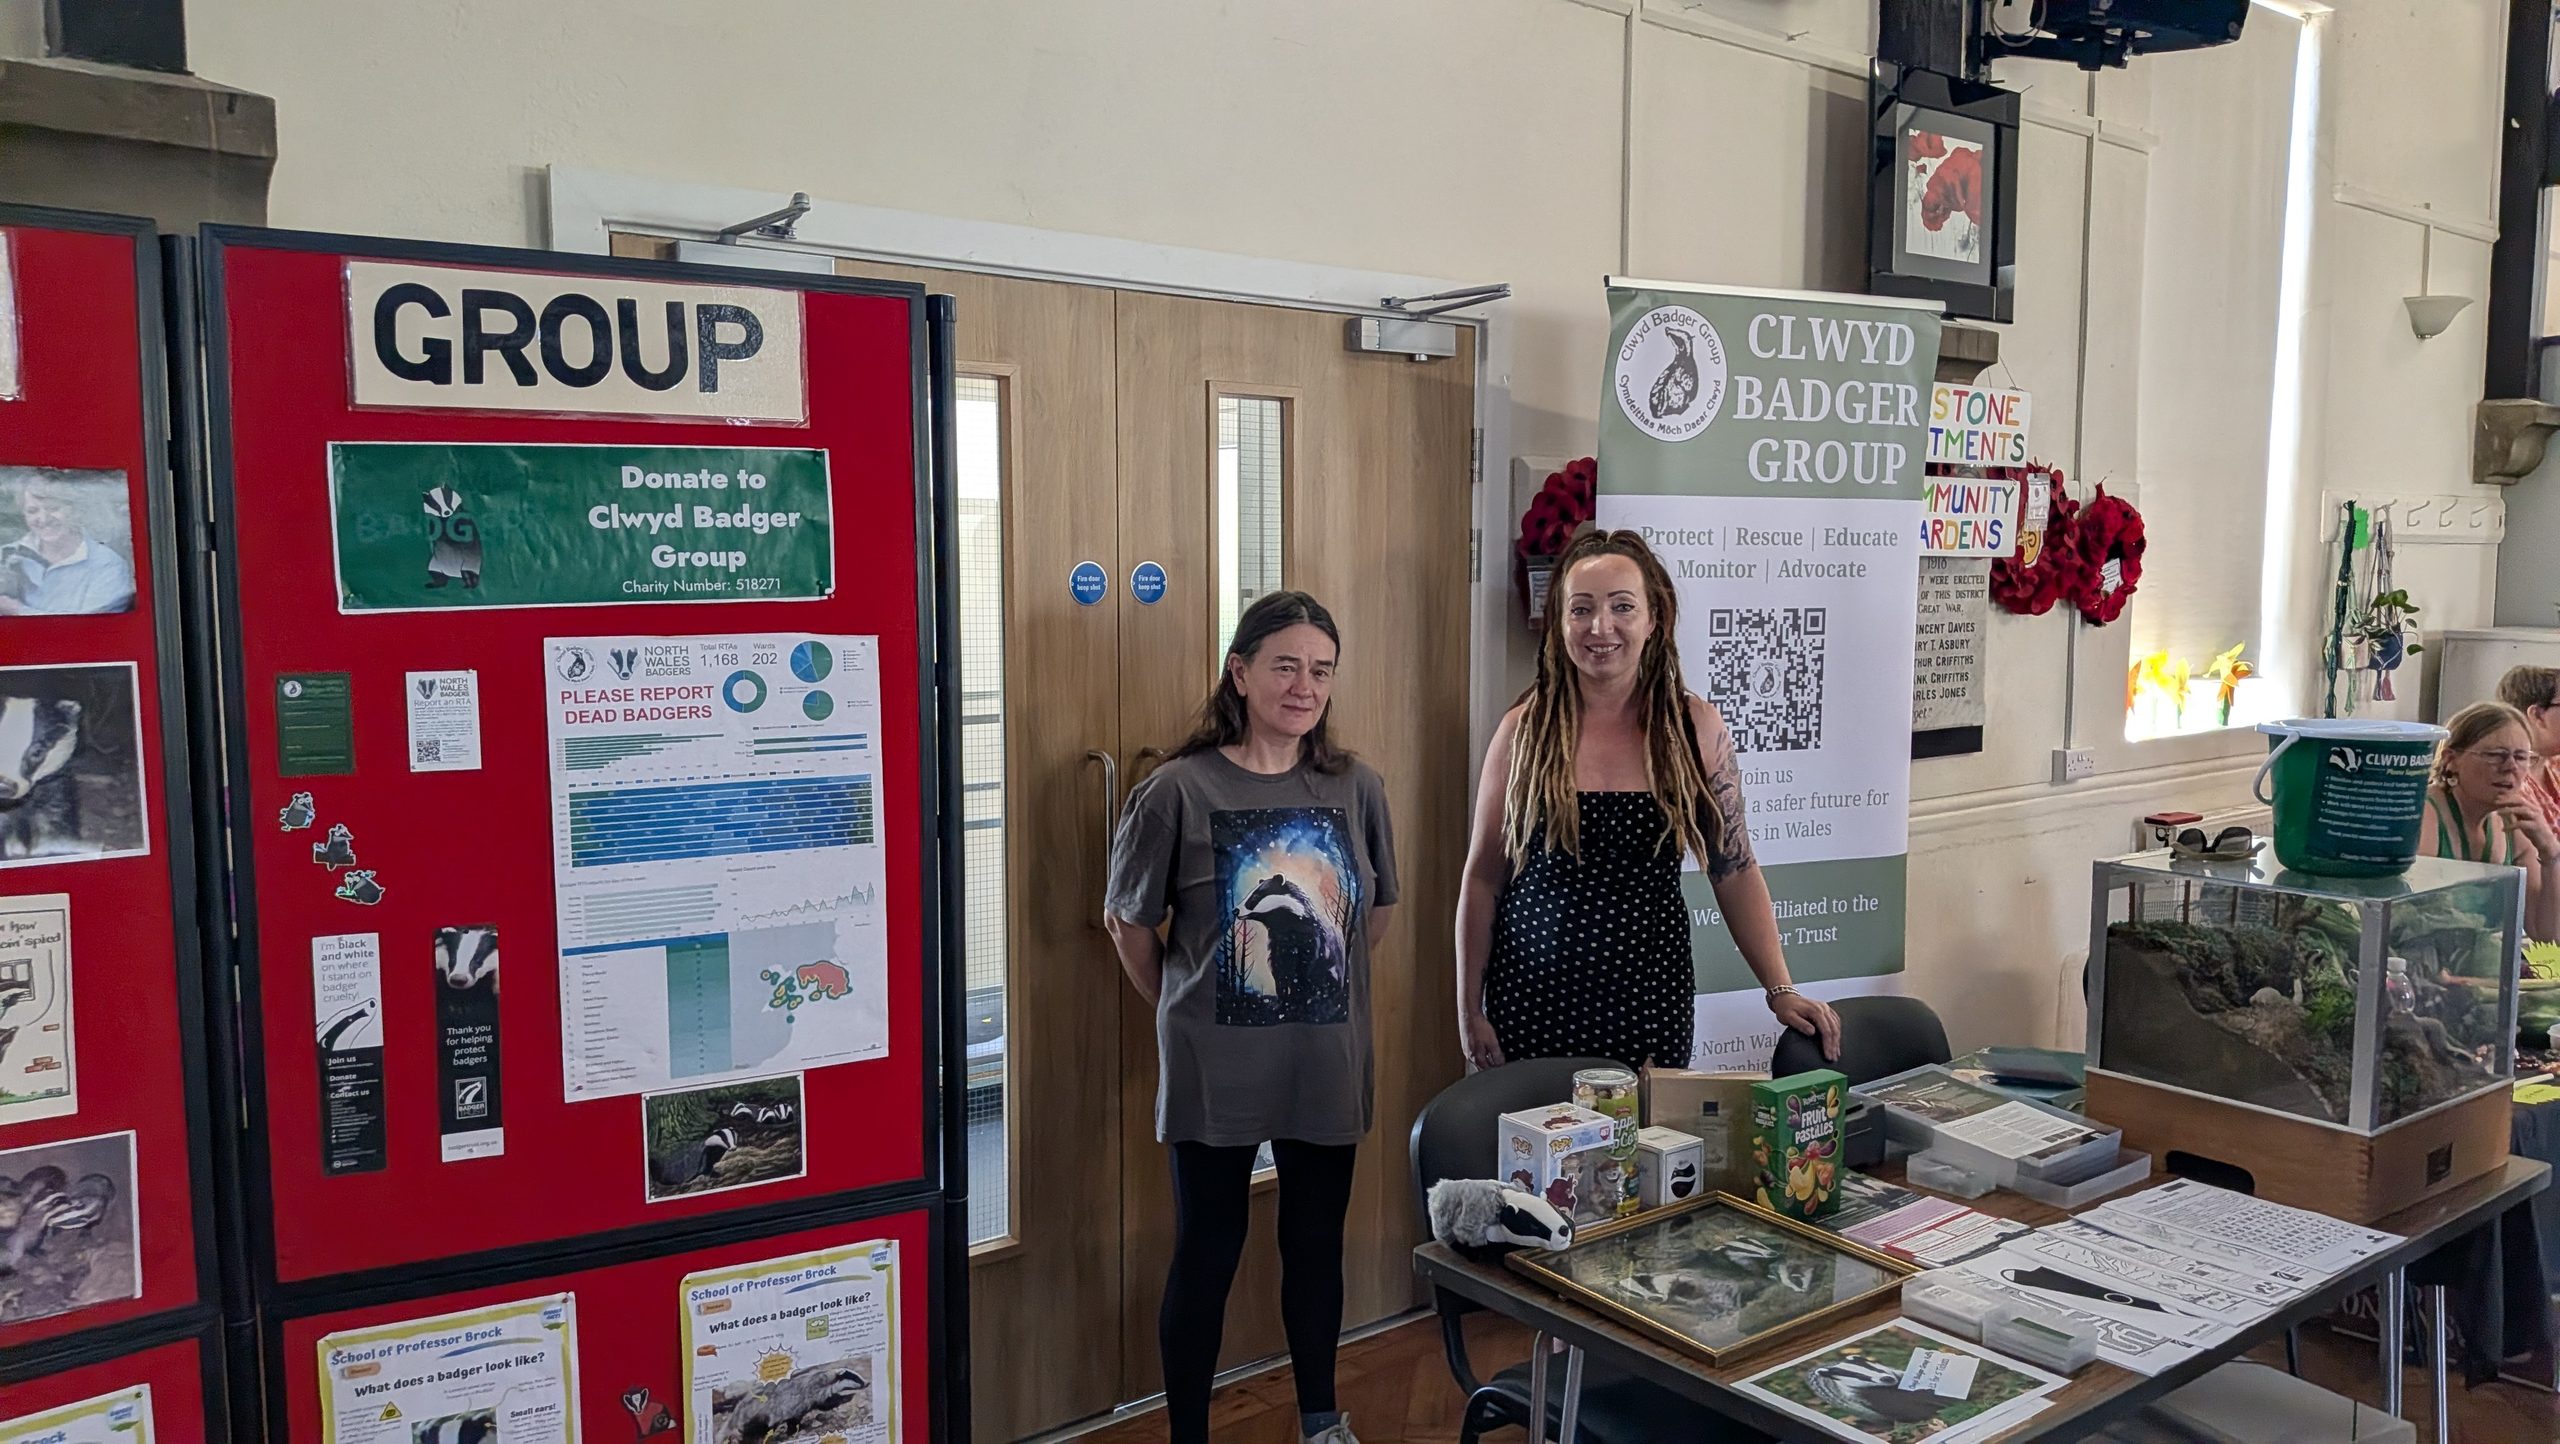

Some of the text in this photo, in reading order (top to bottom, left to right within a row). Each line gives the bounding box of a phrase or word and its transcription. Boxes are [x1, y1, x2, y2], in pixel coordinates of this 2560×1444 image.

[373, 282, 764, 394] GROUP
[1621, 309, 1721, 365] Clwyd Badger Group
[1748, 313, 1915, 366] CLWYD
[1706, 380, 1721, 411] Clwyd
[1733, 376, 1919, 427] BADGER
[1929, 427, 2025, 463] TMENTS
[1748, 438, 1907, 485] GROUP
[621, 466, 766, 490] Donate to
[1923, 482, 2016, 517] MMUNITY
[588, 504, 800, 535] Clwyd Badger
[1641, 526, 1714, 547] Protect
[1735, 527, 1803, 547] Rescue
[1823, 527, 1898, 547] Educate
[1920, 520, 2003, 551] ARDENS
[651, 545, 747, 574] Group
[1677, 559, 1757, 579] Monitor
[1777, 560, 1866, 579] Advocate
[1138, 574, 1148, 582] Fire
[1929, 575, 1949, 585] WERE
[1953, 575, 1985, 585] ERECTED
[622, 577, 781, 595] Charity Number: 518271
[1921, 589, 1986, 600] OF THIS DISTRICT
[1918, 603, 1940, 614] GREAT
[1916, 622, 1975, 635] INCENT DAVIES
[644, 645, 689, 657] NORTH
[701, 643, 738, 651] Total RTAs
[753, 642, 776, 650] Wards
[1939, 639, 1970, 650] ASBURY
[644, 656, 690, 667] WALES
[700, 654, 739, 668] 1,168
[752, 652, 778, 665] 202
[1914, 655, 1974, 668] THUR GRIFFITHS
[645, 667, 691, 677] BADGERS
[1930, 672, 1969, 684] GRIFFITHS
[440, 677, 468, 685] NORTH
[561, 685, 714, 704] PLEASE REPORT
[1940, 687, 1966, 699] JONES
[565, 705, 713, 724] DEAD BADGERS
[2366, 753, 2407, 766] CLWYD
[1775, 770, 1793, 784] us
[1752, 800, 1761, 813] a
[1766, 793, 1806, 812] safer
[1810, 791, 1862, 809] future
[1866, 790, 1890, 806] for
[1764, 824, 1780, 840] in
[1785, 820, 1832, 839] Wales
[1693, 908, 1720, 926] We
[1832, 897, 1848, 912] to
[1853, 895, 1879, 912] the
[1796, 926, 1838, 945] Trust
[338, 939, 366, 949] black
[321, 950, 374, 961] and white
[338, 961, 368, 970] where
[328, 971, 356, 981] stand
[358, 971, 372, 979] on
[322, 981, 358, 992] badger
[447, 1025, 491, 1035] Thank you
[446, 1034, 493, 1046] for helping
[1702, 1037, 1745, 1056] North
[1750, 1032, 1780, 1050] Wal
[454, 1045, 486, 1056] protect
[328, 1057, 345, 1066] Join
[453, 1055, 488, 1066] badgers
[691, 1265, 837, 1301] School of Professor Brock
[709, 1319, 740, 1334] What
[742, 1314, 768, 1327] does
[780, 1304, 818, 1320] badger
[820, 1298, 842, 1311] look
[845, 1292, 871, 1306] like?
[331, 1326, 502, 1366] School of Professor Brock
[354, 1352, 546, 1398] What does a badger look like?
[510, 1403, 556, 1418] Small ears!
